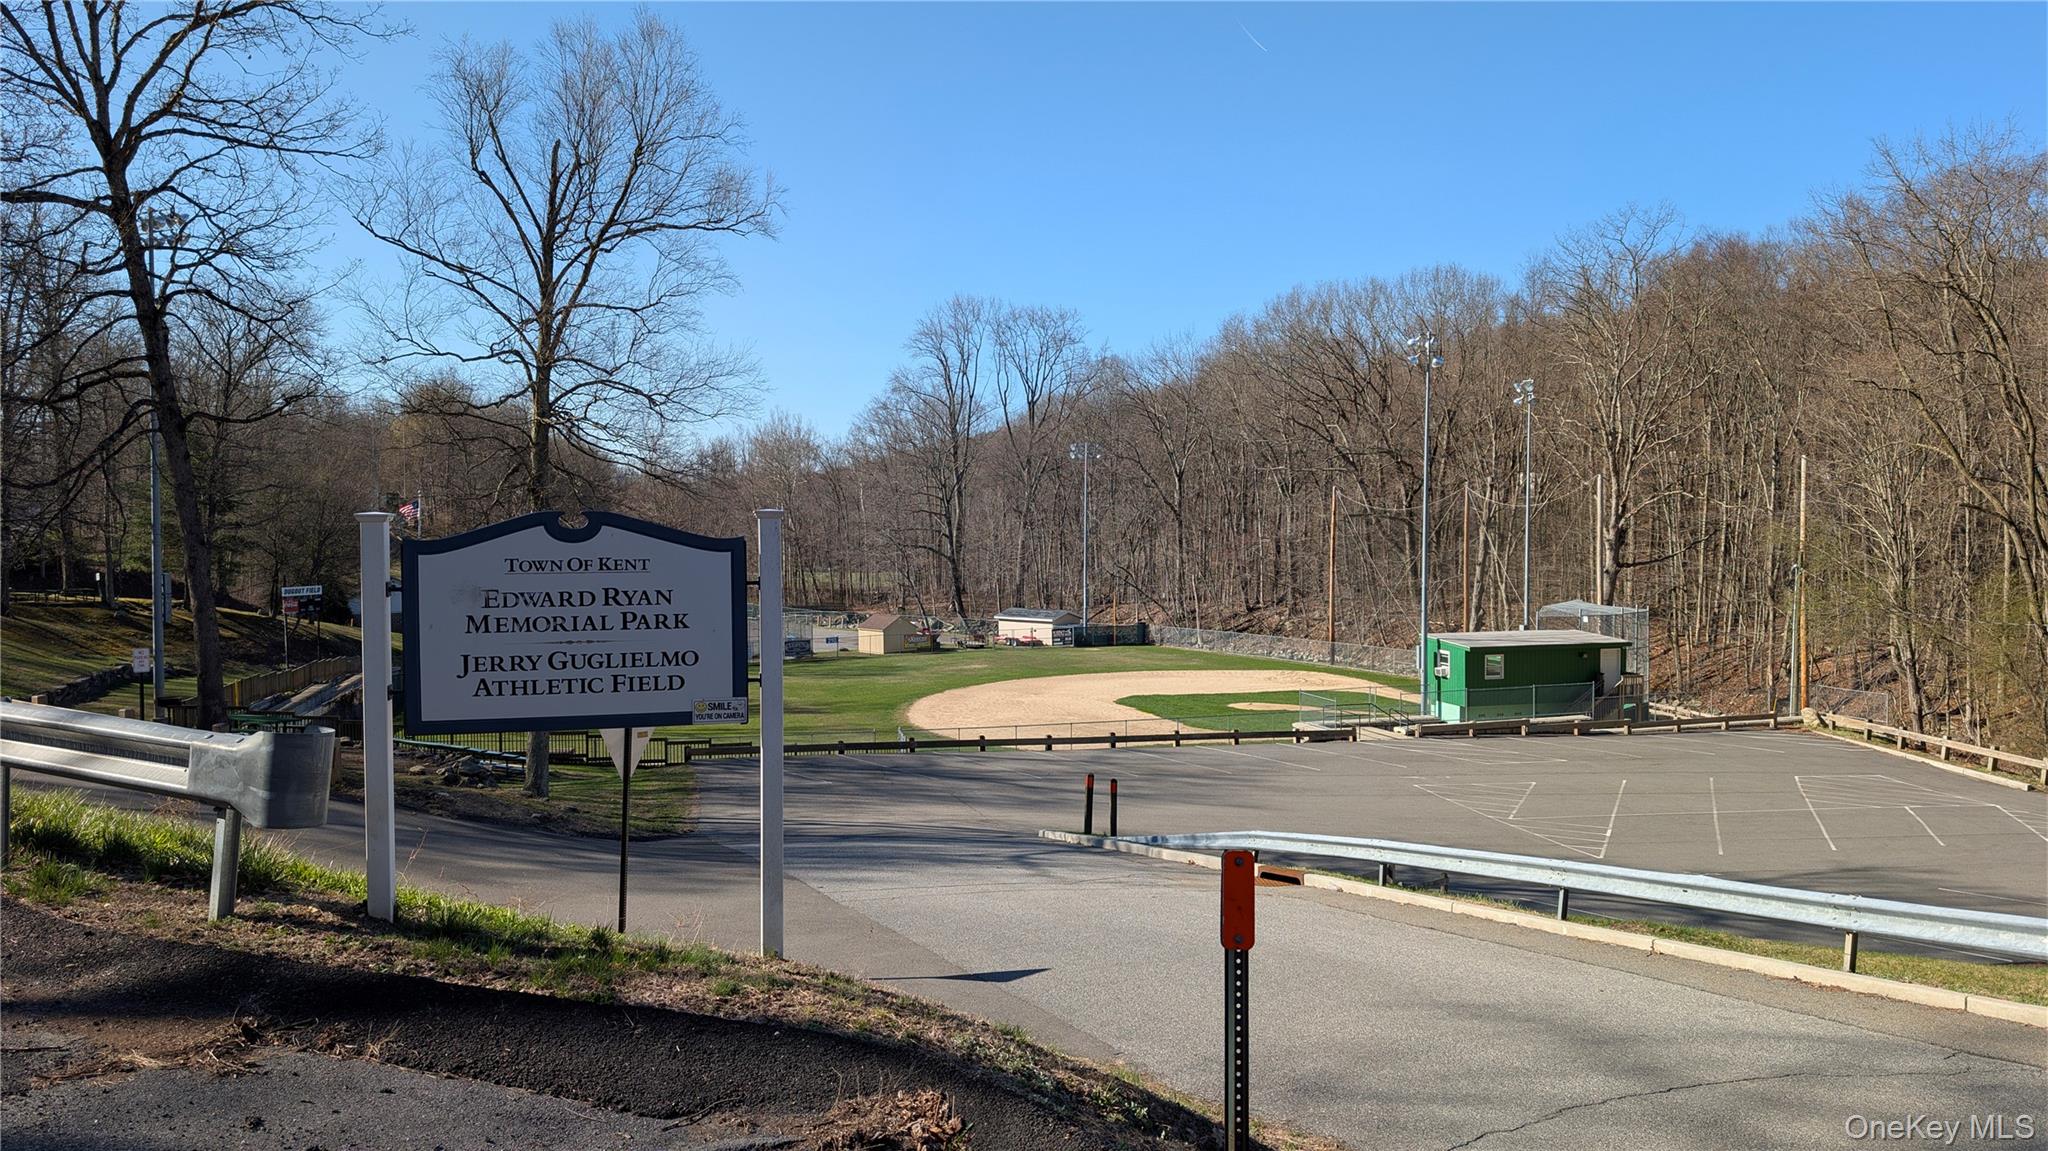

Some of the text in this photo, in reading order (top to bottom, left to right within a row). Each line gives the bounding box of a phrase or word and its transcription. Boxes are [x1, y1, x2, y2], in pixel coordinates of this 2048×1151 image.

[504, 557, 651, 573] TOWN OF KENT
[481, 587, 673, 609] EDWARD RYAN
[464, 611, 690, 634] MEMORIAL PARK
[456, 649, 700, 679] JERRY GUGLIELMO
[472, 674, 686, 697] ATHLETIC FIELD
[707, 701, 732, 711] SMILE
